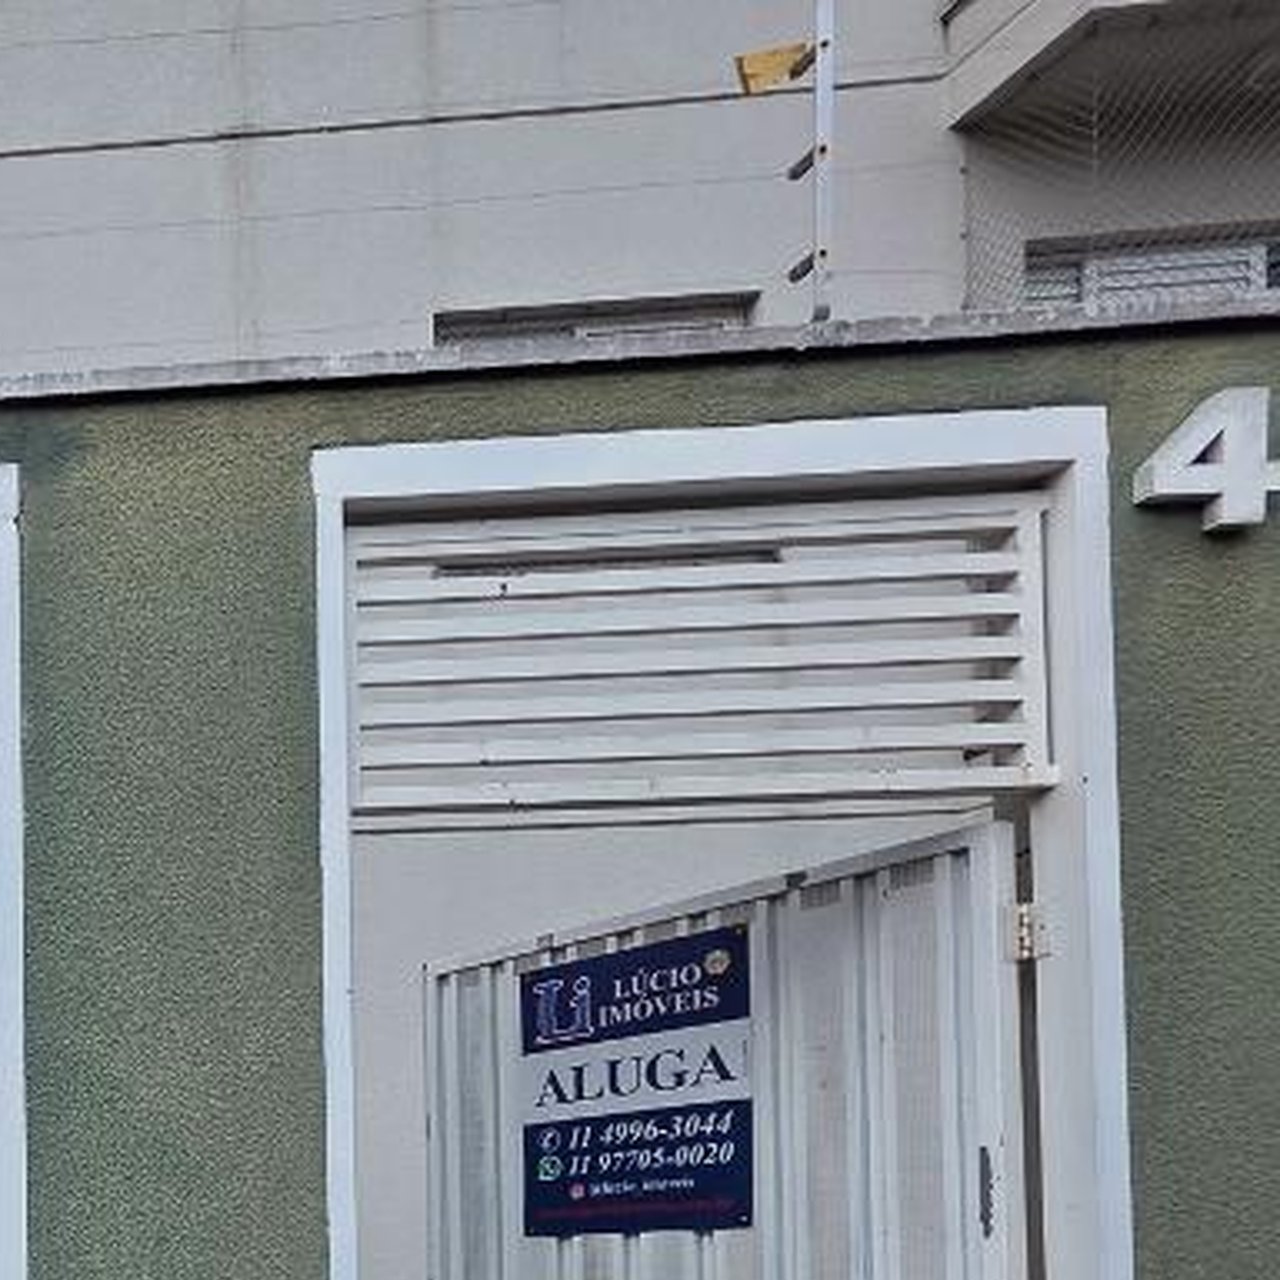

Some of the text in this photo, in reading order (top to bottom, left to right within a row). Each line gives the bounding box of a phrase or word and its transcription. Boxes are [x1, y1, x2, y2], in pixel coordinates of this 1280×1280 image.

[1133, 386, 1280, 530] 4
[613, 963, 702, 999] LÚCIO
[598, 986, 721, 1028] IMÓVEIS
[535, 1043, 738, 1108] ALUGA
[599, 1110, 734, 1145] 4996-3044
